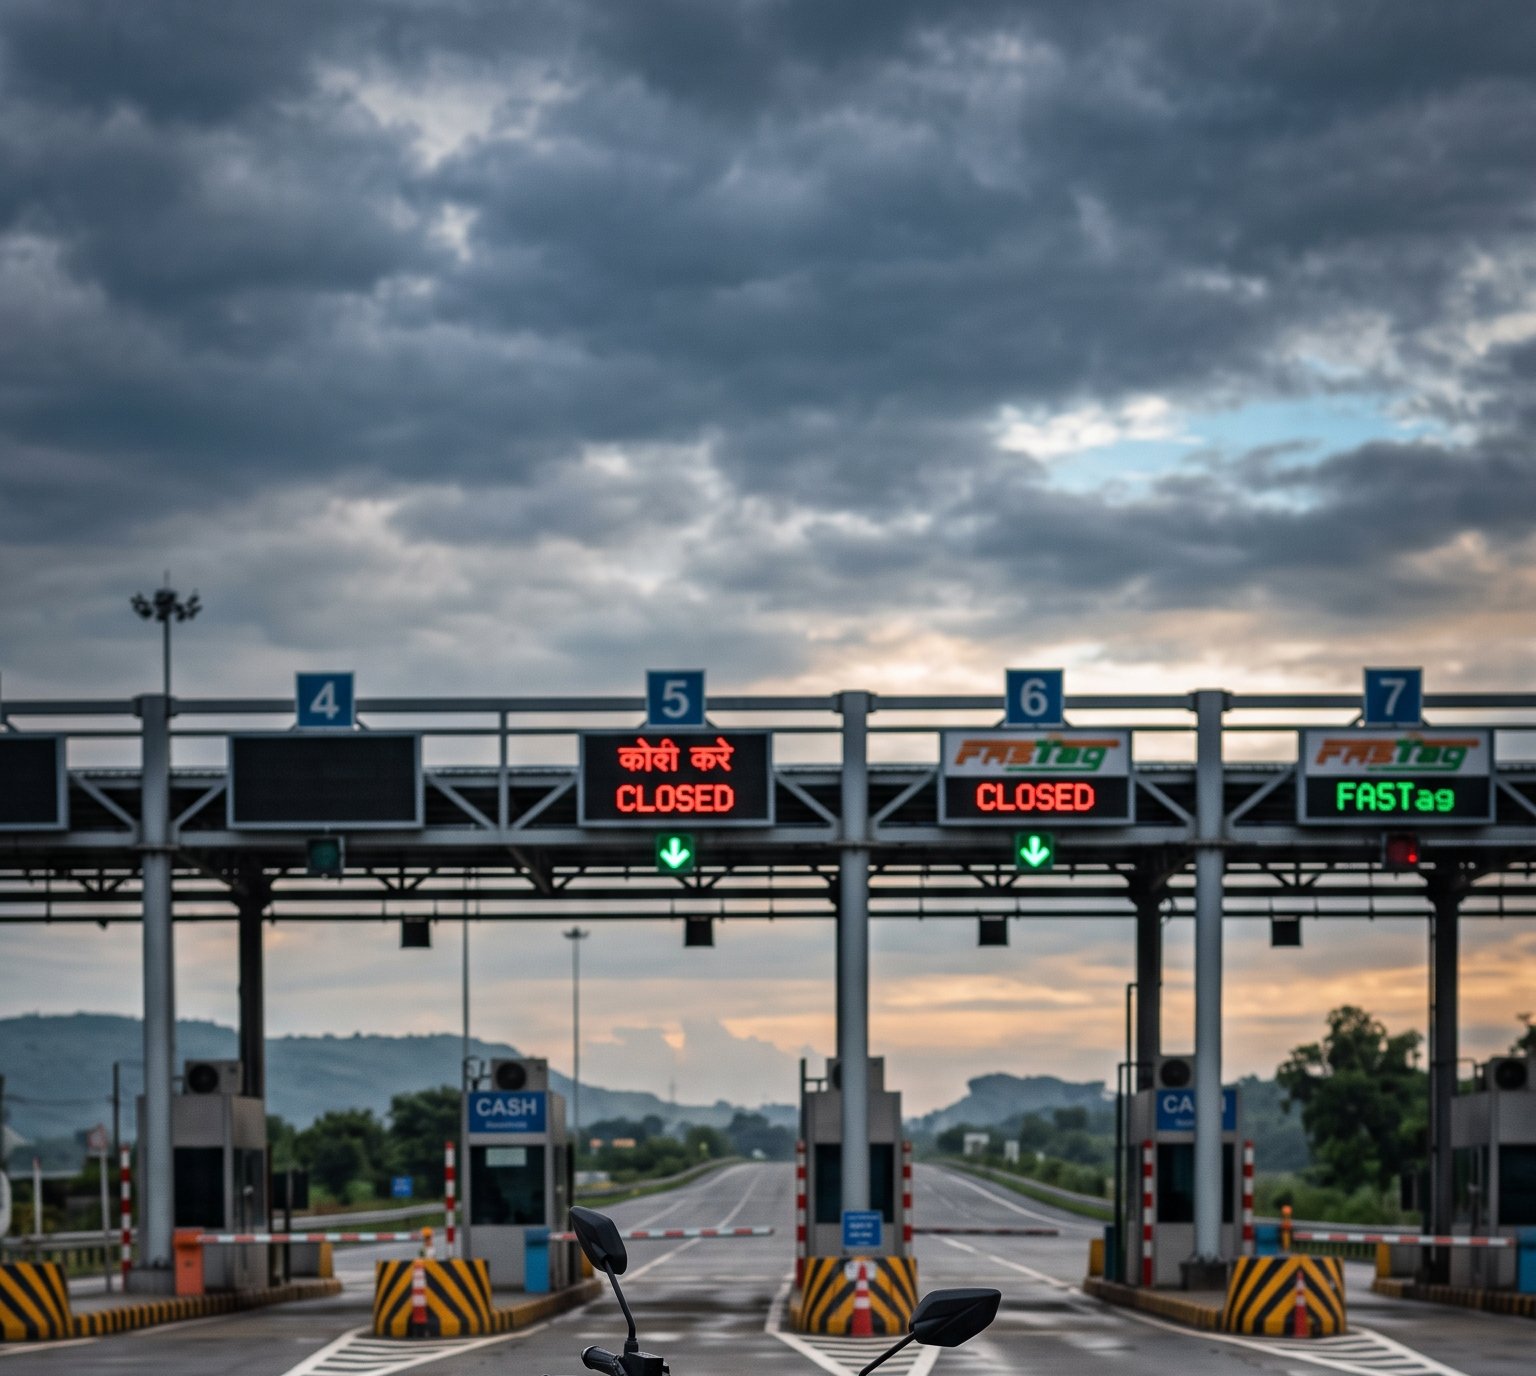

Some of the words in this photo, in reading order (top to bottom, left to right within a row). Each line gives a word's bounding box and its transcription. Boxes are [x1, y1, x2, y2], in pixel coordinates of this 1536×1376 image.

[310, 681, 340, 720] 4
[662, 679, 690, 719] 5
[1021, 678, 1048, 717] 6
[1380, 678, 1407, 716] 7
[955, 739, 1120, 772] FASTag
[1316, 739, 1480, 772] FASTag
[616, 784, 734, 812] CLOSED
[976, 782, 1095, 811] CLOSED
[1336, 782, 1455, 812] FASTag
[476, 1097, 537, 1117] CASH
